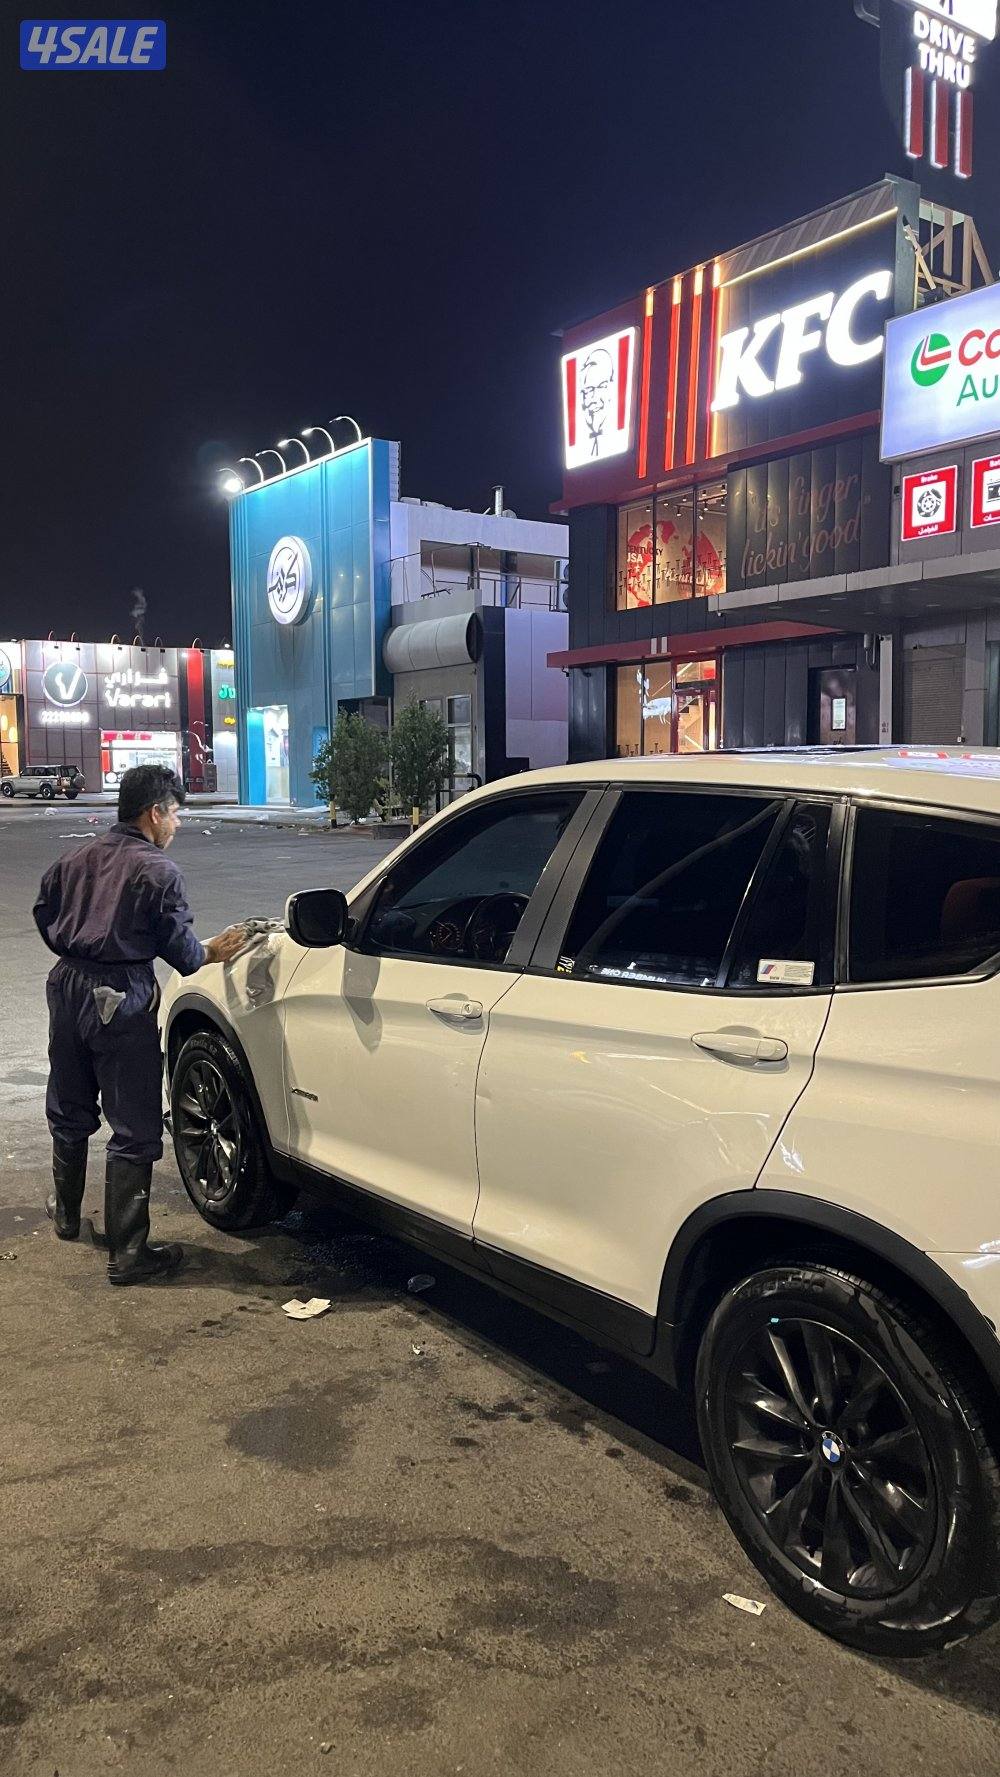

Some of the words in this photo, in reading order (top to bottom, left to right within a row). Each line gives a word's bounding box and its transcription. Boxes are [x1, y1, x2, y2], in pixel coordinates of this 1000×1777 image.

[914, 10, 975, 63] DRIVE
[918, 42, 970, 89] THRU
[711, 270, 892, 412] KFC
[56, 668, 83, 700] V
[104, 687, 172, 708] Varari
